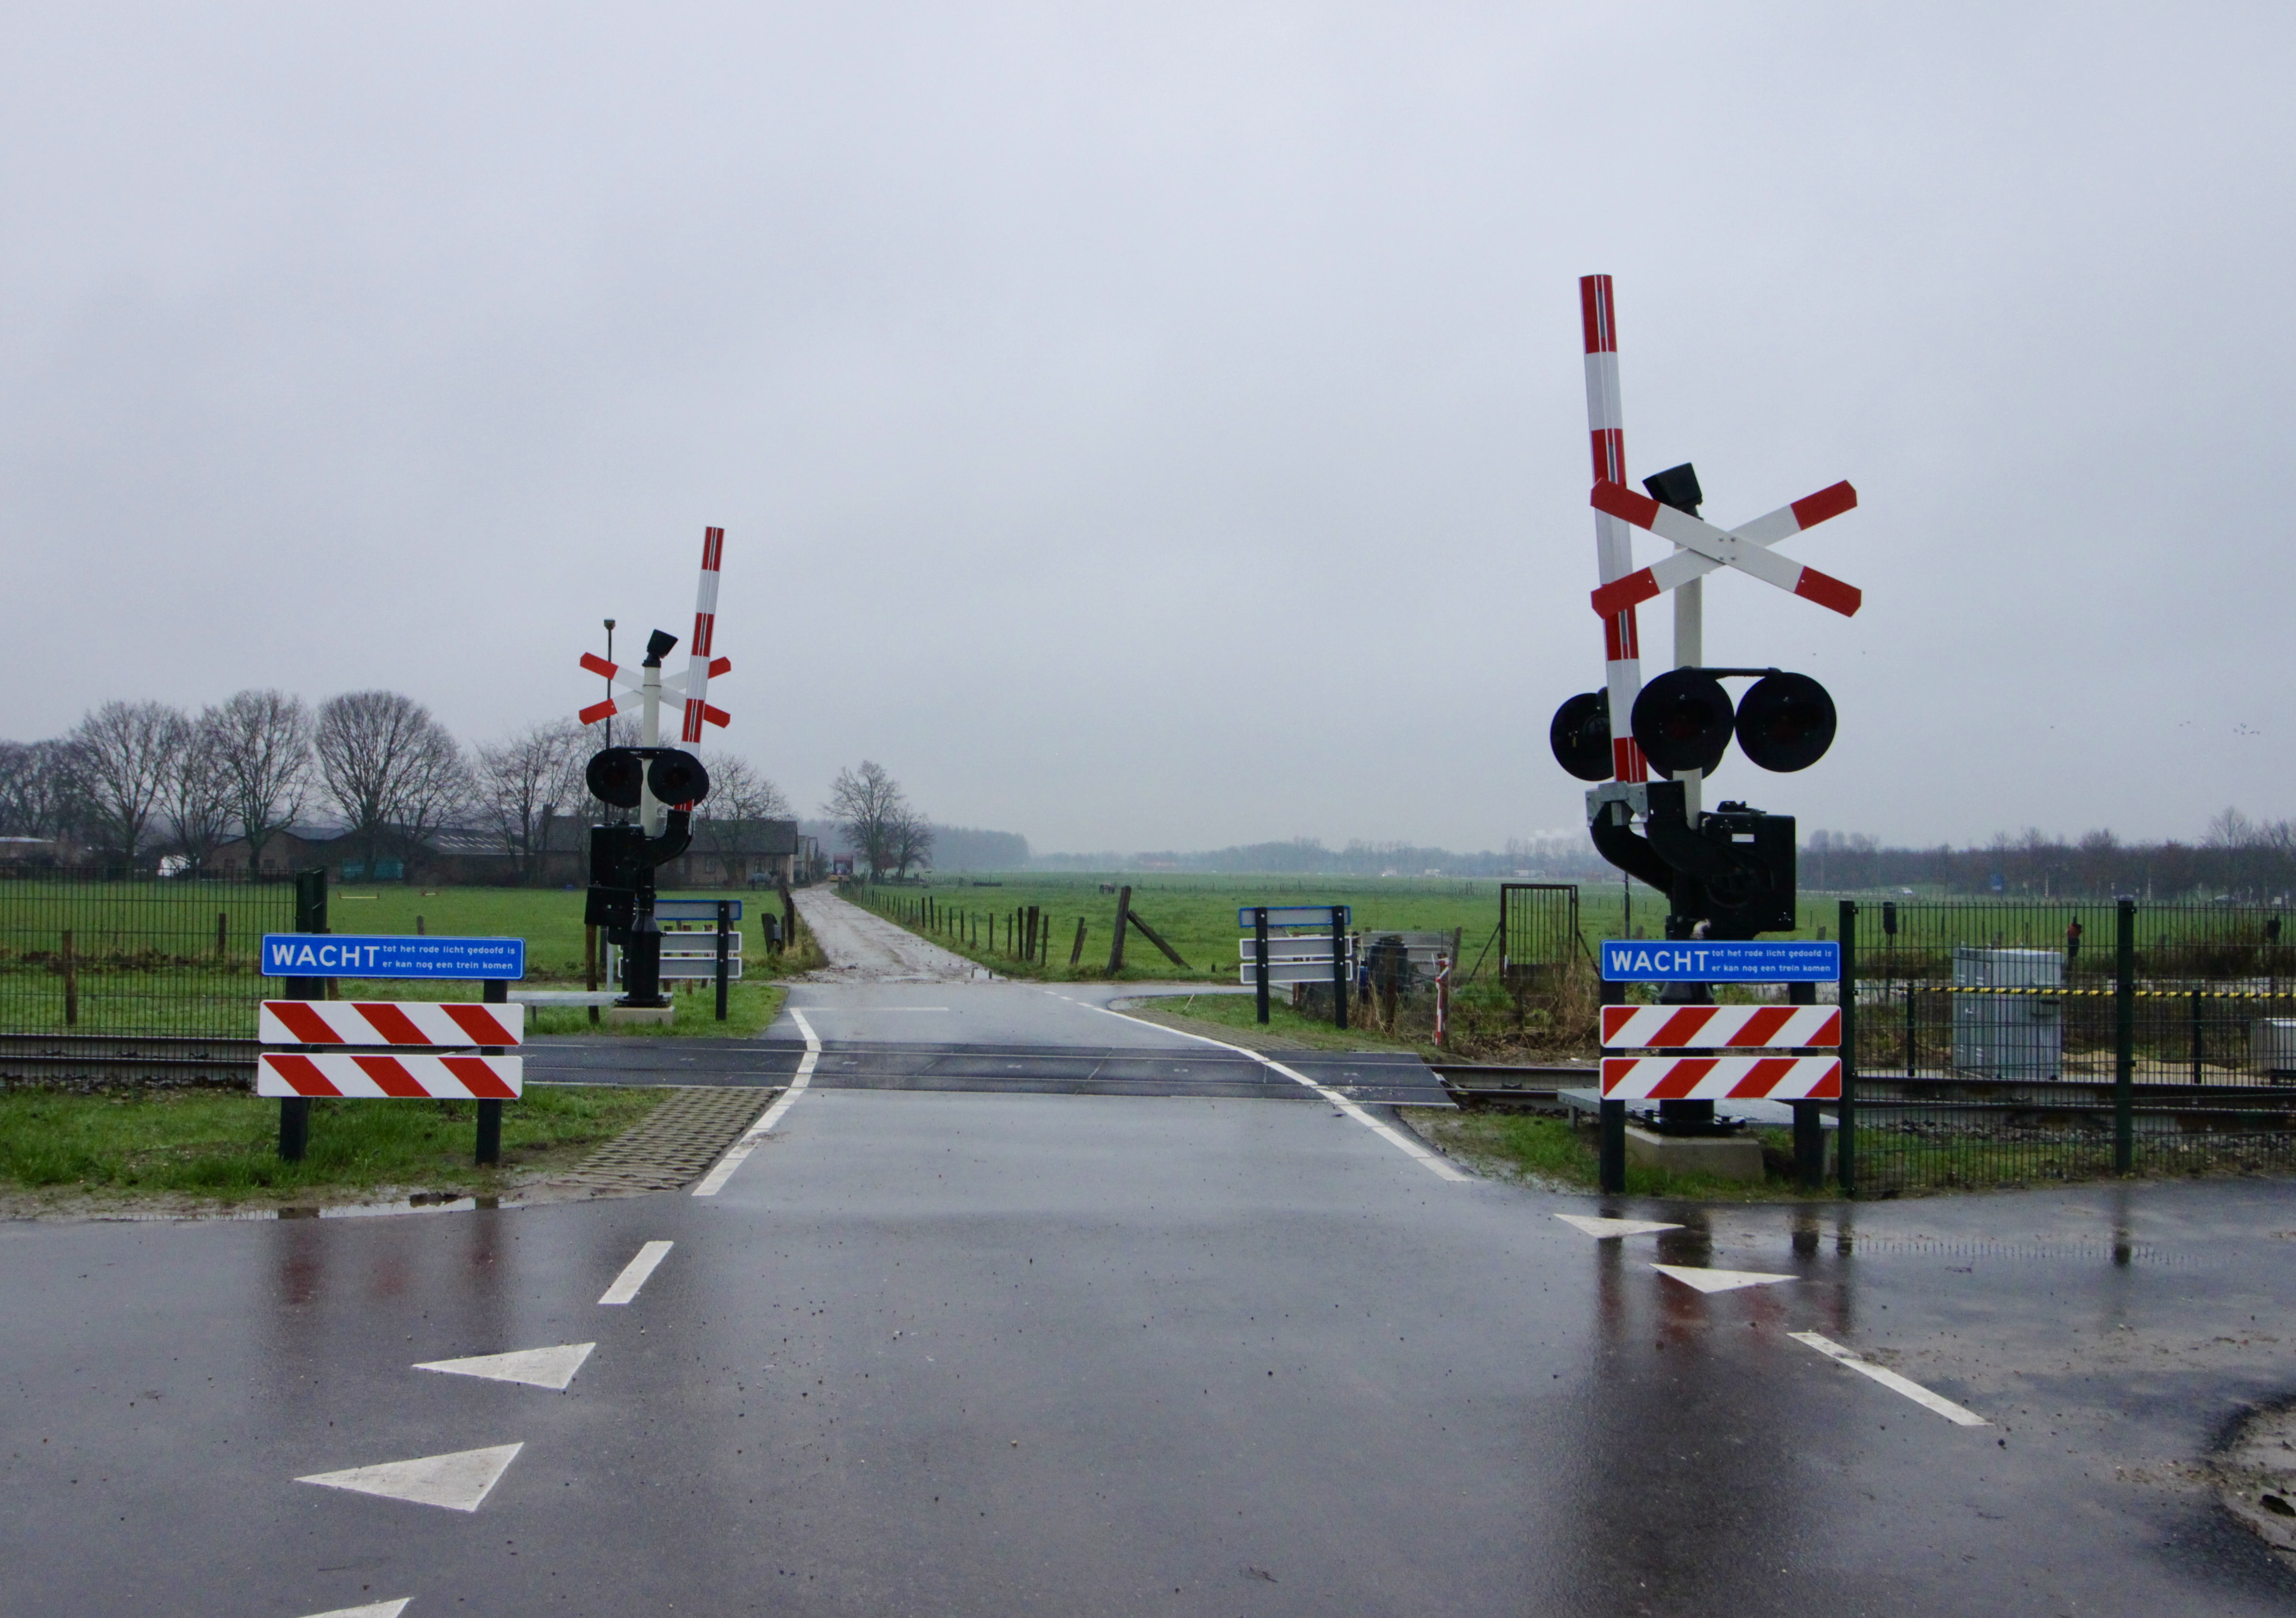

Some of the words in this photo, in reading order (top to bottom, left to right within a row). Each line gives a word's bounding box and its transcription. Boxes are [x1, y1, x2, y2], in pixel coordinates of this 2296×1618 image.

[272, 944, 380, 967] WACHT
[467, 947, 503, 955] gedoofd
[1789, 950, 1821, 959] gedoofd
[1611, 950, 1709, 972] WACHT
